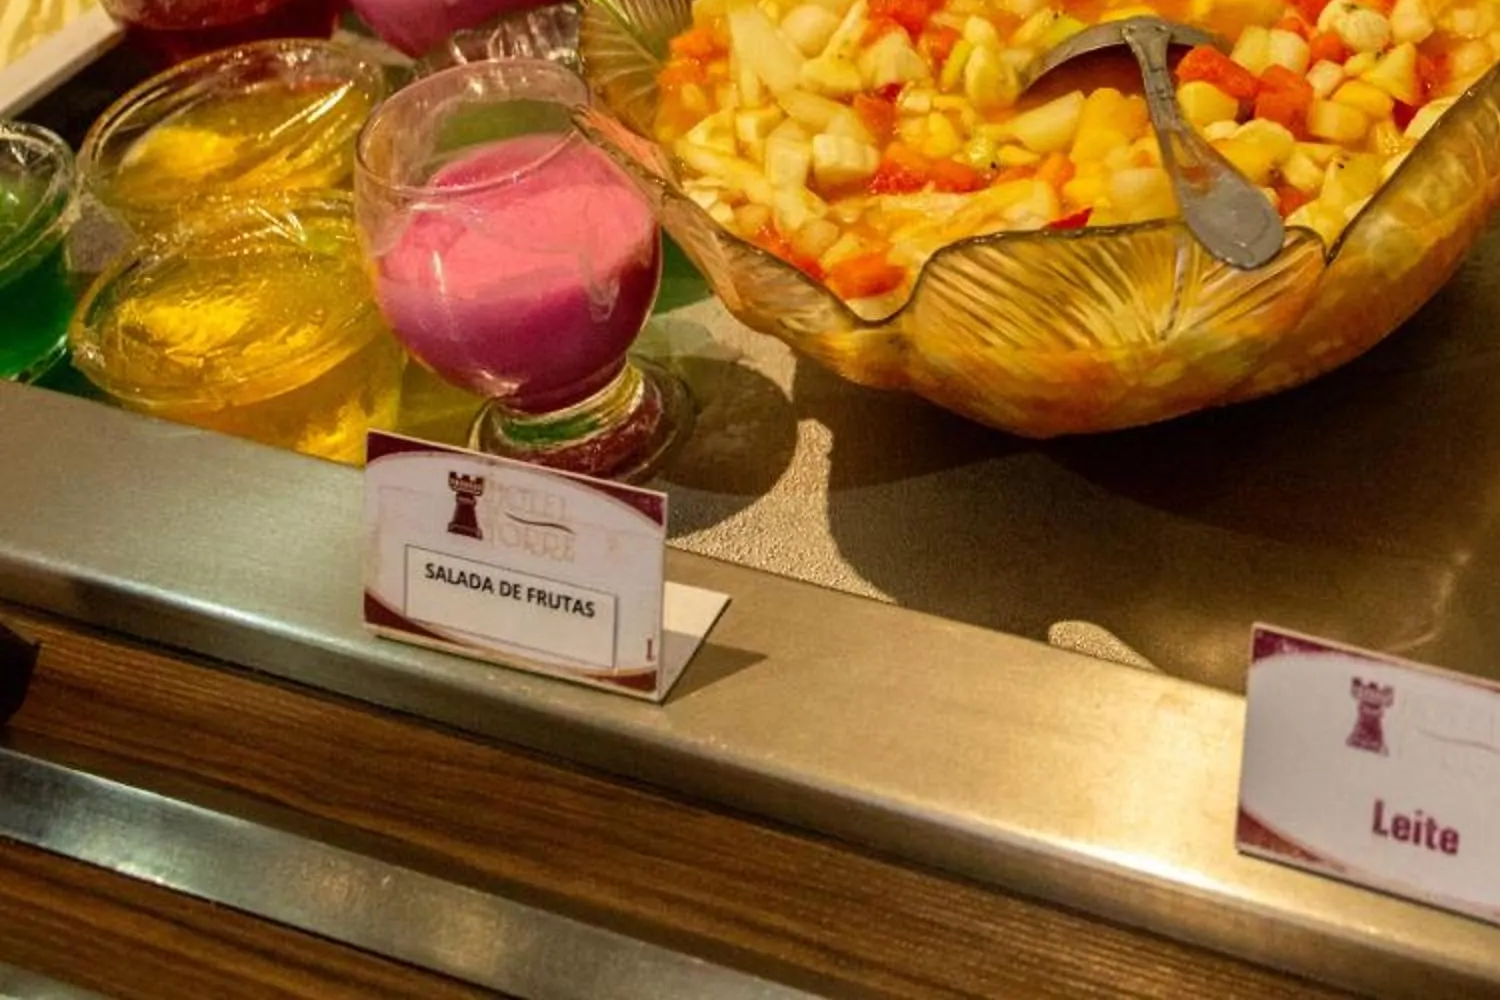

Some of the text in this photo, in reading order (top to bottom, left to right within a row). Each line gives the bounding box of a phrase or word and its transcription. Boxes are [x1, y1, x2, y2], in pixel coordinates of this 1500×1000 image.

[424, 562, 596, 618] SALADA DE FRUTAS
[1372, 799, 1460, 855] Leite
